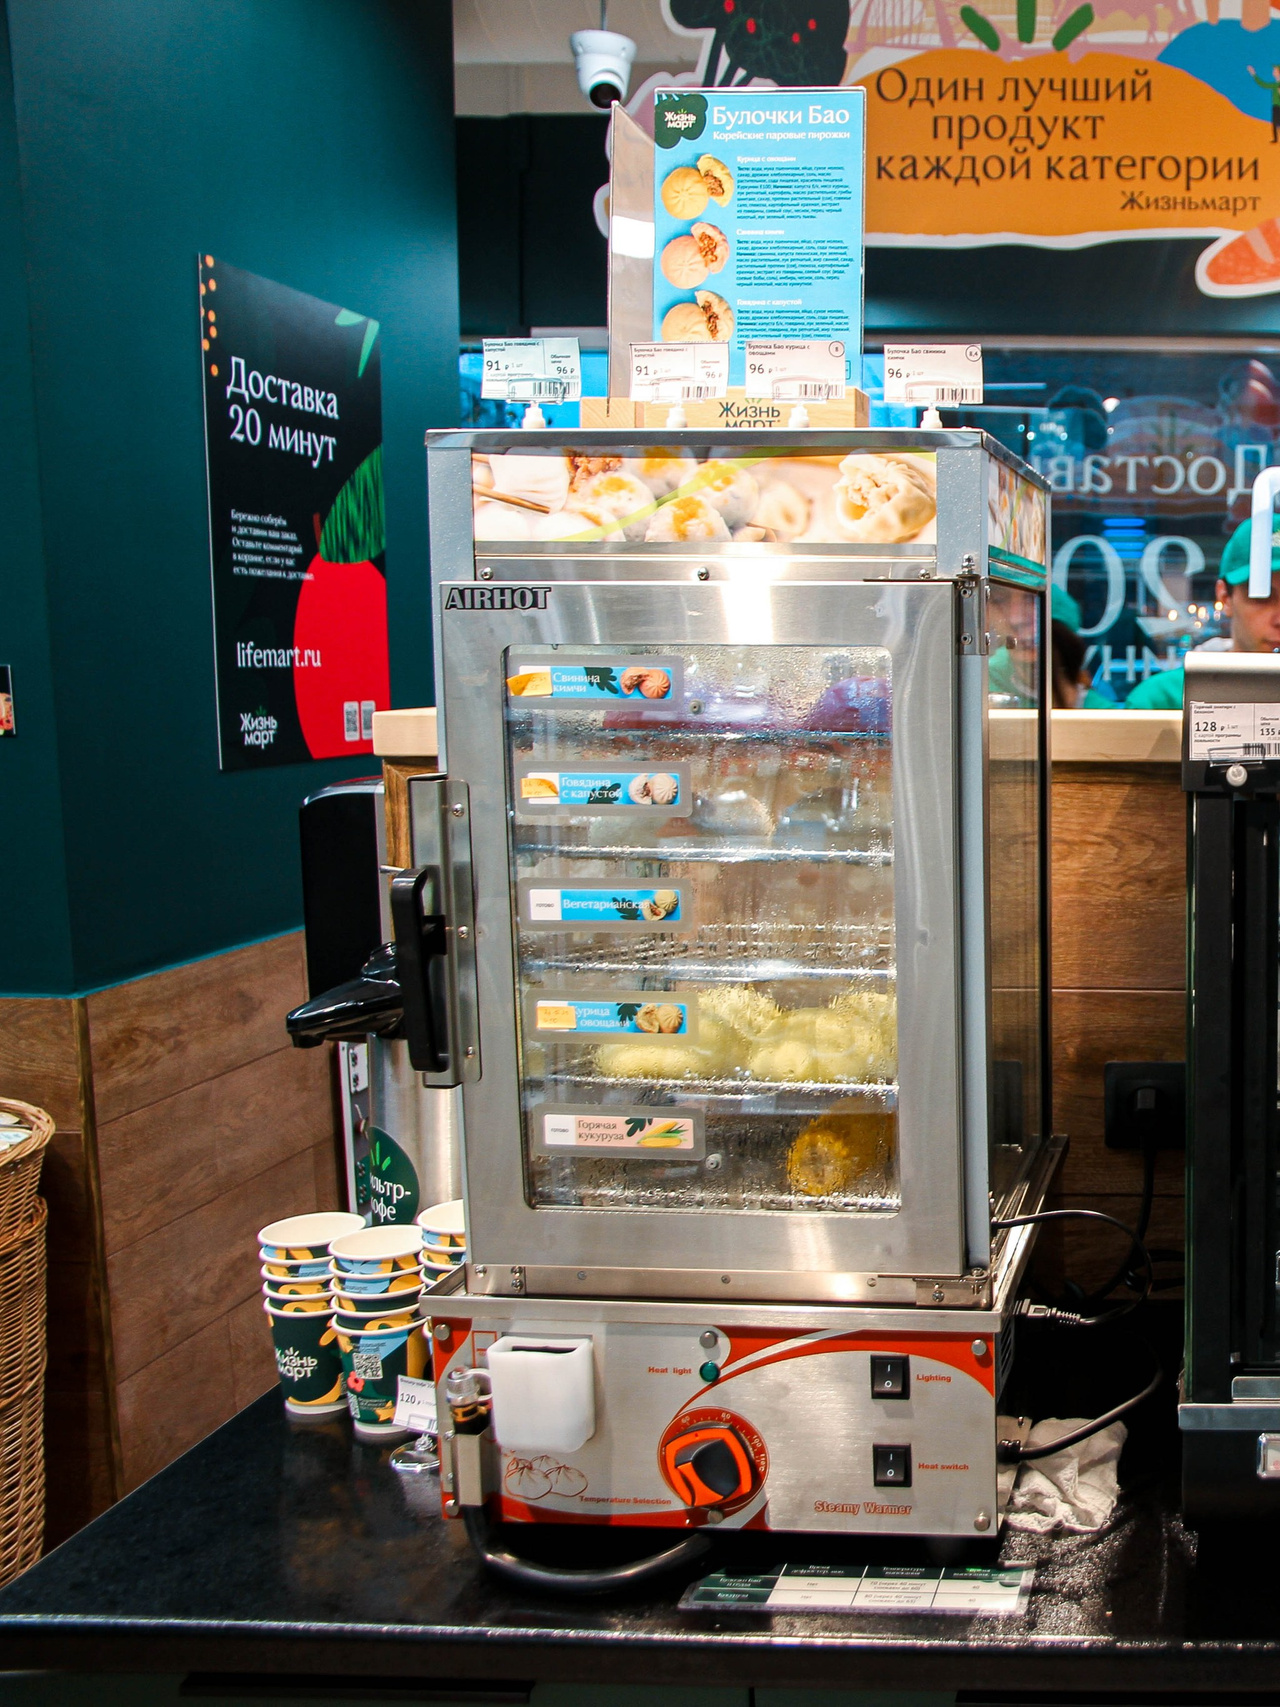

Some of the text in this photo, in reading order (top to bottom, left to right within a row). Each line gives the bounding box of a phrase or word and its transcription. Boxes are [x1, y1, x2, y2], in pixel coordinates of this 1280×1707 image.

[876, 68, 1152, 111] Один лучший
[664, 111, 697, 122] Жизнь
[713, 105, 850, 130] Булочки Бао
[667, 120, 694, 130] март
[713, 131, 850, 142] Корейские паровые пирожки
[932, 113, 1104, 149] продукт
[876, 147, 1259, 190] каждой категории
[1121, 191, 1262, 216] Жизньмарт
[486, 360, 501, 371] 91
[556, 366, 568, 374] 96
[635, 365, 649, 376] 91
[749, 363, 765, 374] 96
[705, 371, 716, 379] 96
[887, 367, 902, 378] 96
[226, 356, 339, 420] Доставка
[719, 402, 781, 418] Жизнь
[229, 404, 337, 469] 20 минут
[445, 586, 552, 610] AIRHOT
[236, 641, 322, 668] lifemart.ru
[552, 672, 600, 683] Свинина
[552, 683, 587, 693] кимчи
[240, 713, 278, 731] Жизнь
[1195, 721, 1217, 732] 128
[1260, 728, 1276, 736] 135
[244, 730, 275, 749] март
[561, 777, 611, 789] Говядина
[562, 788, 623, 800] с капустой
[563, 899, 651, 910] Вегетарианская
[580, 1018, 630, 1029] овощами
[577, 1120, 617, 1131] Горячая
[578, 1131, 625, 1142] кукуруза
[370, 1172, 411, 1204] ильтр-
[371, 1197, 396, 1223] офе
[673, 1366, 692, 1375] light
[916, 1374, 952, 1382] Lighting
[400, 1392, 416, 1404] 120
[918, 1462, 939, 1470] Heat
[580, 1495, 672, 1505] Temperature Selection
[814, 1500, 913, 1515] Steamy Warmer
